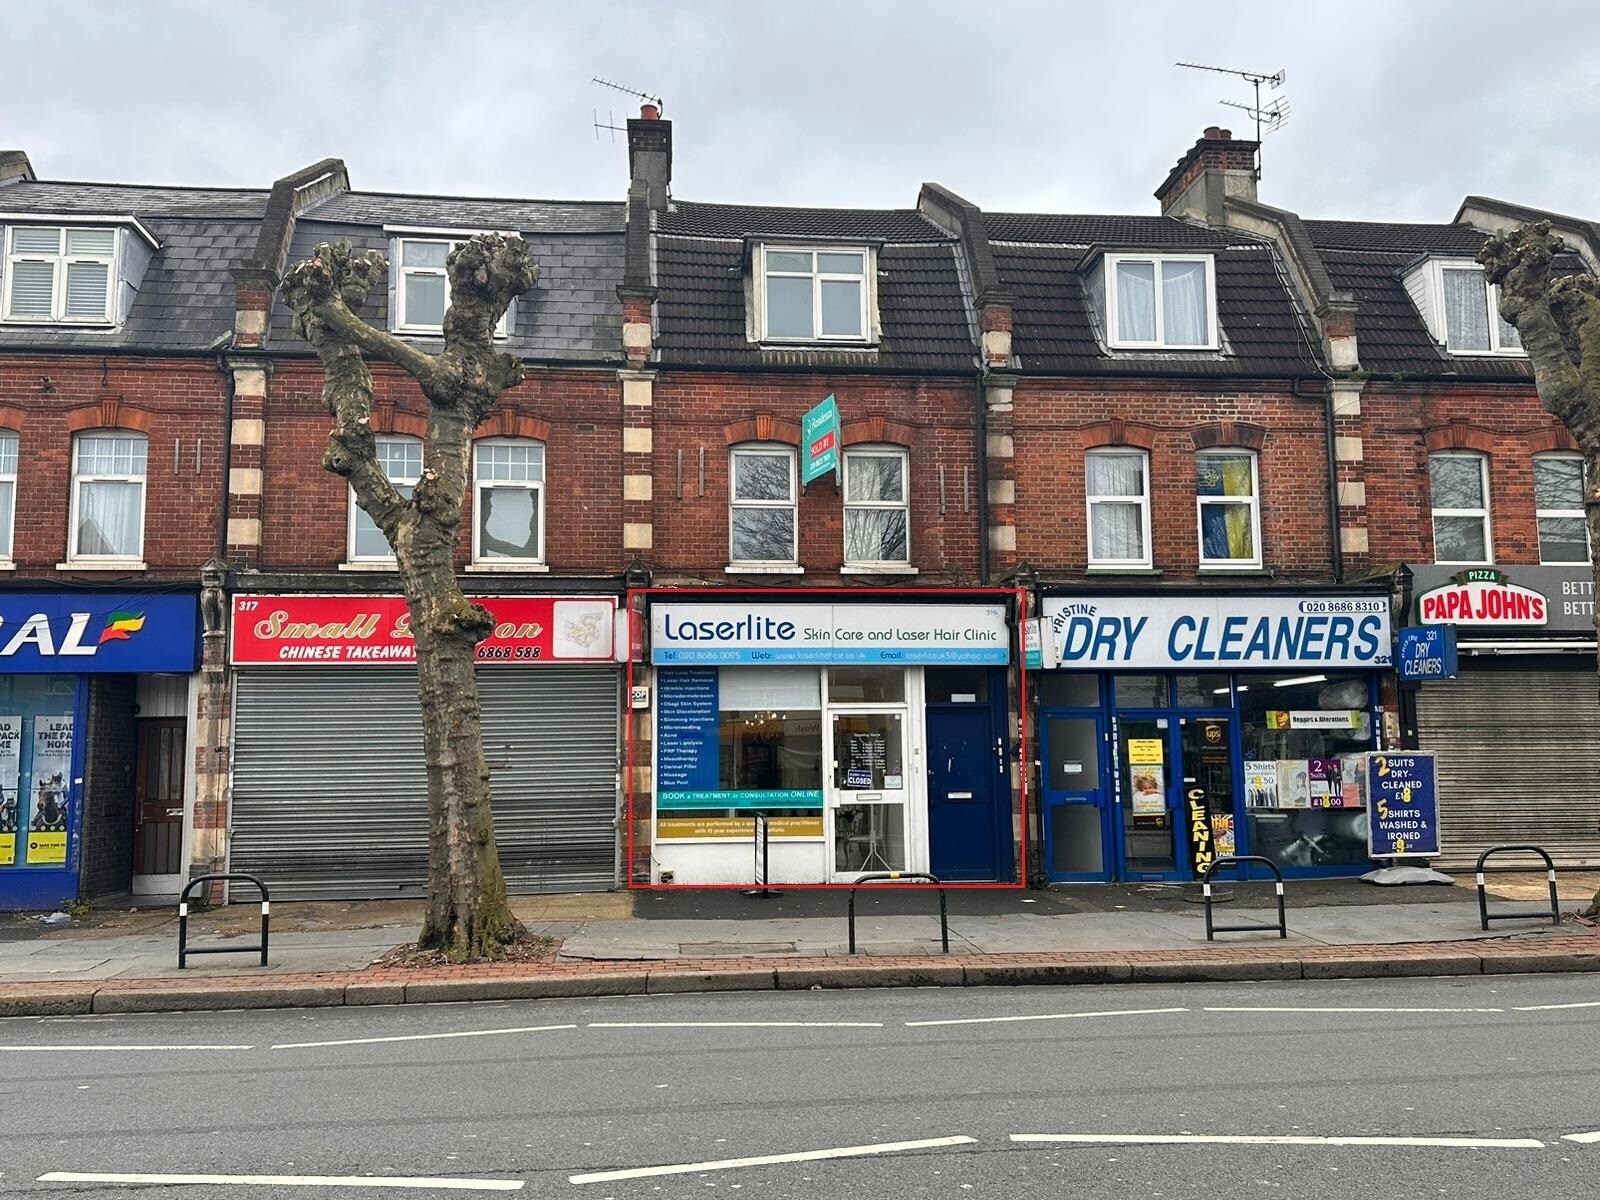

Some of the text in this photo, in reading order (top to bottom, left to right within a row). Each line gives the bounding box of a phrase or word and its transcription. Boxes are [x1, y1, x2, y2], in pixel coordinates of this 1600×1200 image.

[1469, 570, 1495, 580] PIZZA
[1562, 581, 1594, 595] BETT
[238, 601, 259, 611] 317
[1306, 602, 1380, 611] 020 8686 8310
[1424, 589, 1544, 619] PAPA JOHN'S
[1563, 601, 1596, 615] BETT
[1053, 603, 1097, 634] PRISTINE
[253, 610, 382, 640] Small
[665, 614, 997, 641] Laserlite Skin Care and Laser Hair Clinic
[0, 613, 98, 655] AL
[1062, 615, 1381, 661] DRY CLEANERS
[1426, 631, 1437, 640] 321
[279, 645, 342, 659] CHINESE
[478, 646, 541, 659] 6868 588
[679, 651, 694, 659] 020
[751, 651, 772, 660] Web:
[1415, 642, 1430, 658] DRY
[1374, 655, 1392, 664] 321
[1404, 657, 1442, 676] CLEANERS
[37, 732, 72, 740] THE PA
[1246, 762, 1252, 770] 5
[1253, 762, 1275, 770] Shirts
[1314, 760, 1322, 772] 2
[1375, 756, 1415, 777] 2 SUITS
[1391, 770, 1413, 778] DRY-
[848, 776, 871, 785] CLOSED
[1381, 781, 1422, 789] CLEANED
[662, 792, 685, 800] BOOK
[1377, 799, 1420, 820] 5 SHIRTS
[1187, 788, 1212, 874] CLEANING
[1380, 821, 1418, 829] WASHED
[1387, 832, 1420, 840] IRONED
